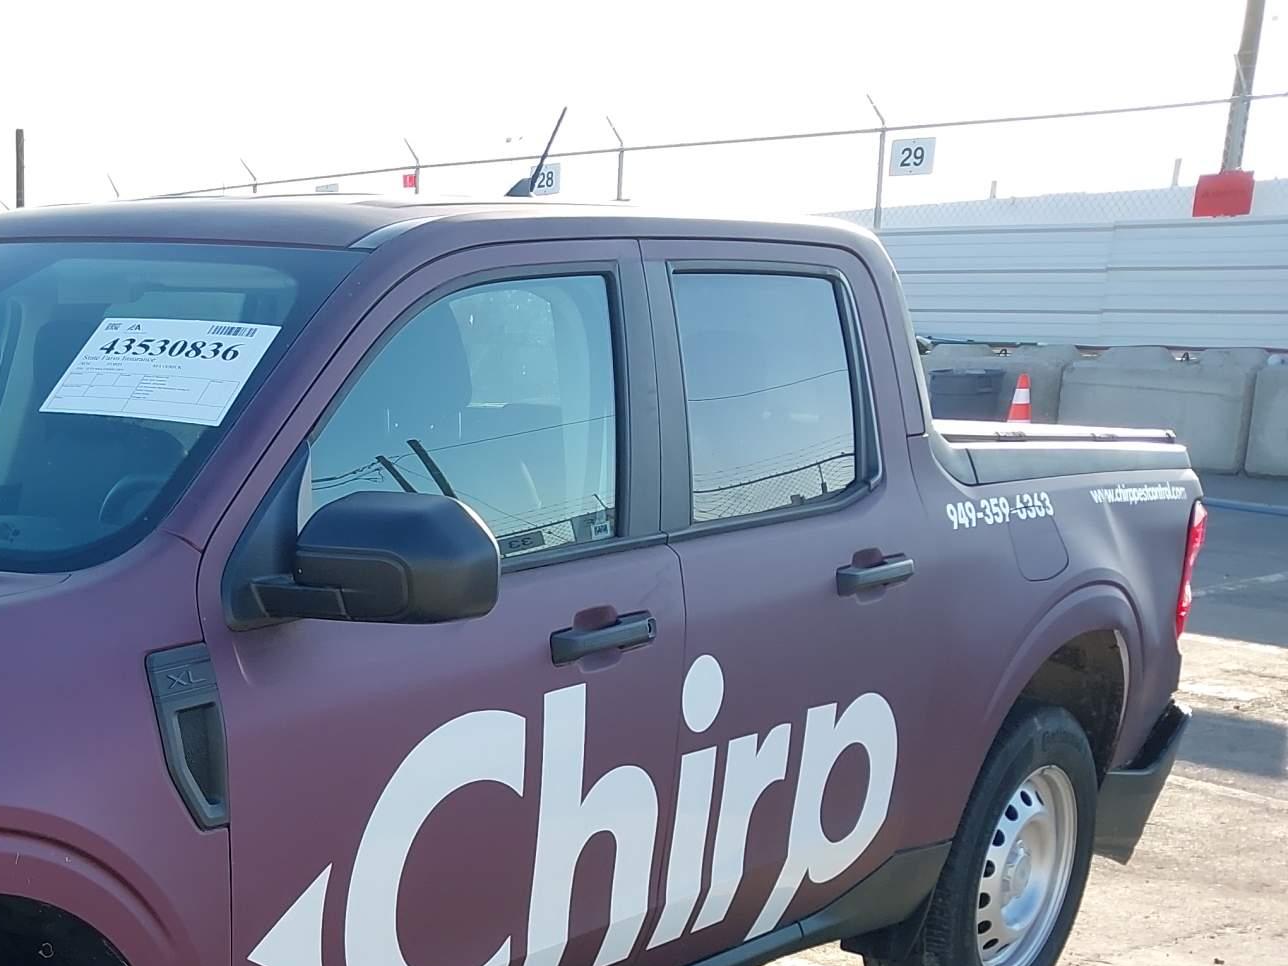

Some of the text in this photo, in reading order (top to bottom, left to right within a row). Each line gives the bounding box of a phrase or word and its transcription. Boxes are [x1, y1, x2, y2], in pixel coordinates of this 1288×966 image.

[900, 146, 925, 167] 29
[537, 171, 554, 188] 28
[99, 338, 246, 361] 43530836
[946, 491, 1054, 530] 949-359-6363
[167, 670, 207, 690] XL
